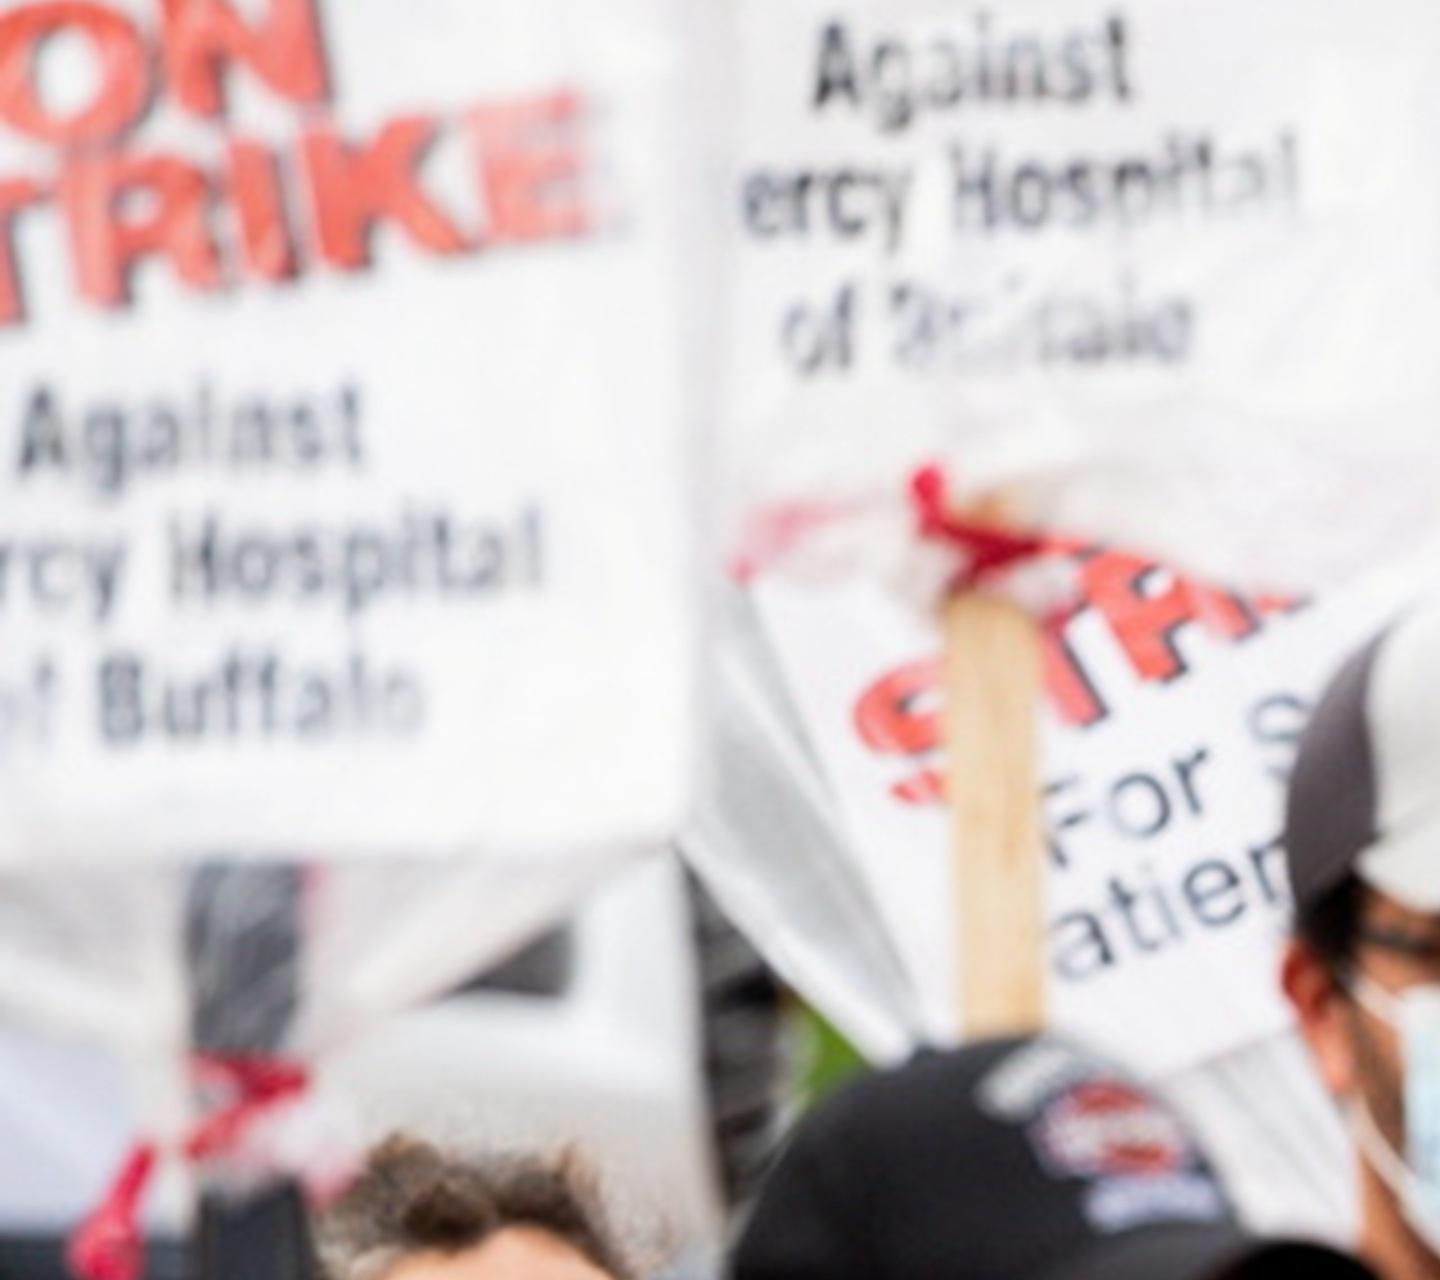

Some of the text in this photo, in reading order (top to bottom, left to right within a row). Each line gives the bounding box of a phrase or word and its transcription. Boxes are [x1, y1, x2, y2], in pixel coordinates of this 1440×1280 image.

[812, 8, 1134, 128] Against
[741, 166, 910, 252] ercy
[17, 382, 365, 498] Against
[0, 505, 545, 625] rcy Hospital
[1038, 745, 1214, 870] For
